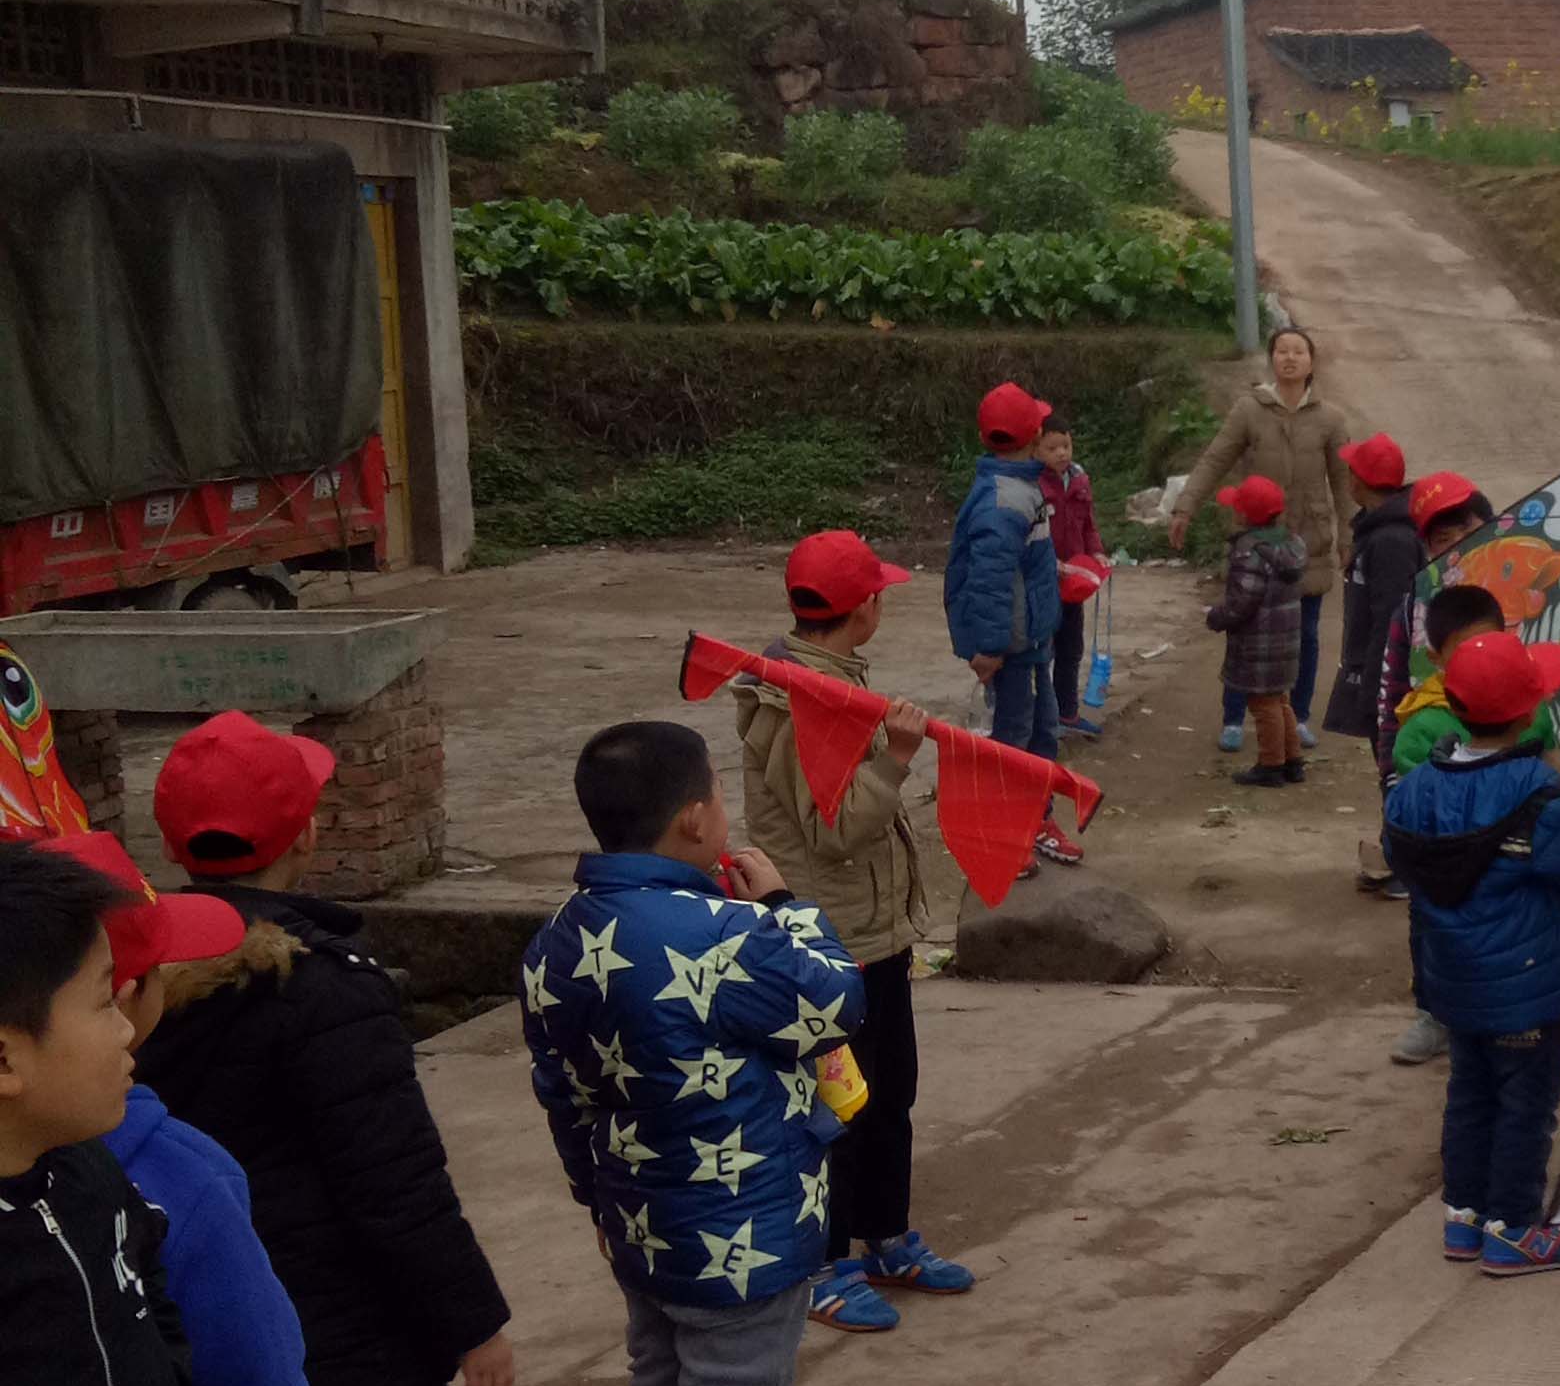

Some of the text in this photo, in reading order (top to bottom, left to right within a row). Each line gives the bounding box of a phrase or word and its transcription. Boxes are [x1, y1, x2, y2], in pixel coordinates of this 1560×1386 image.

[701, 1063, 720, 1087] R
[716, 1148, 735, 1175] E
[722, 1242, 746, 1274] E
